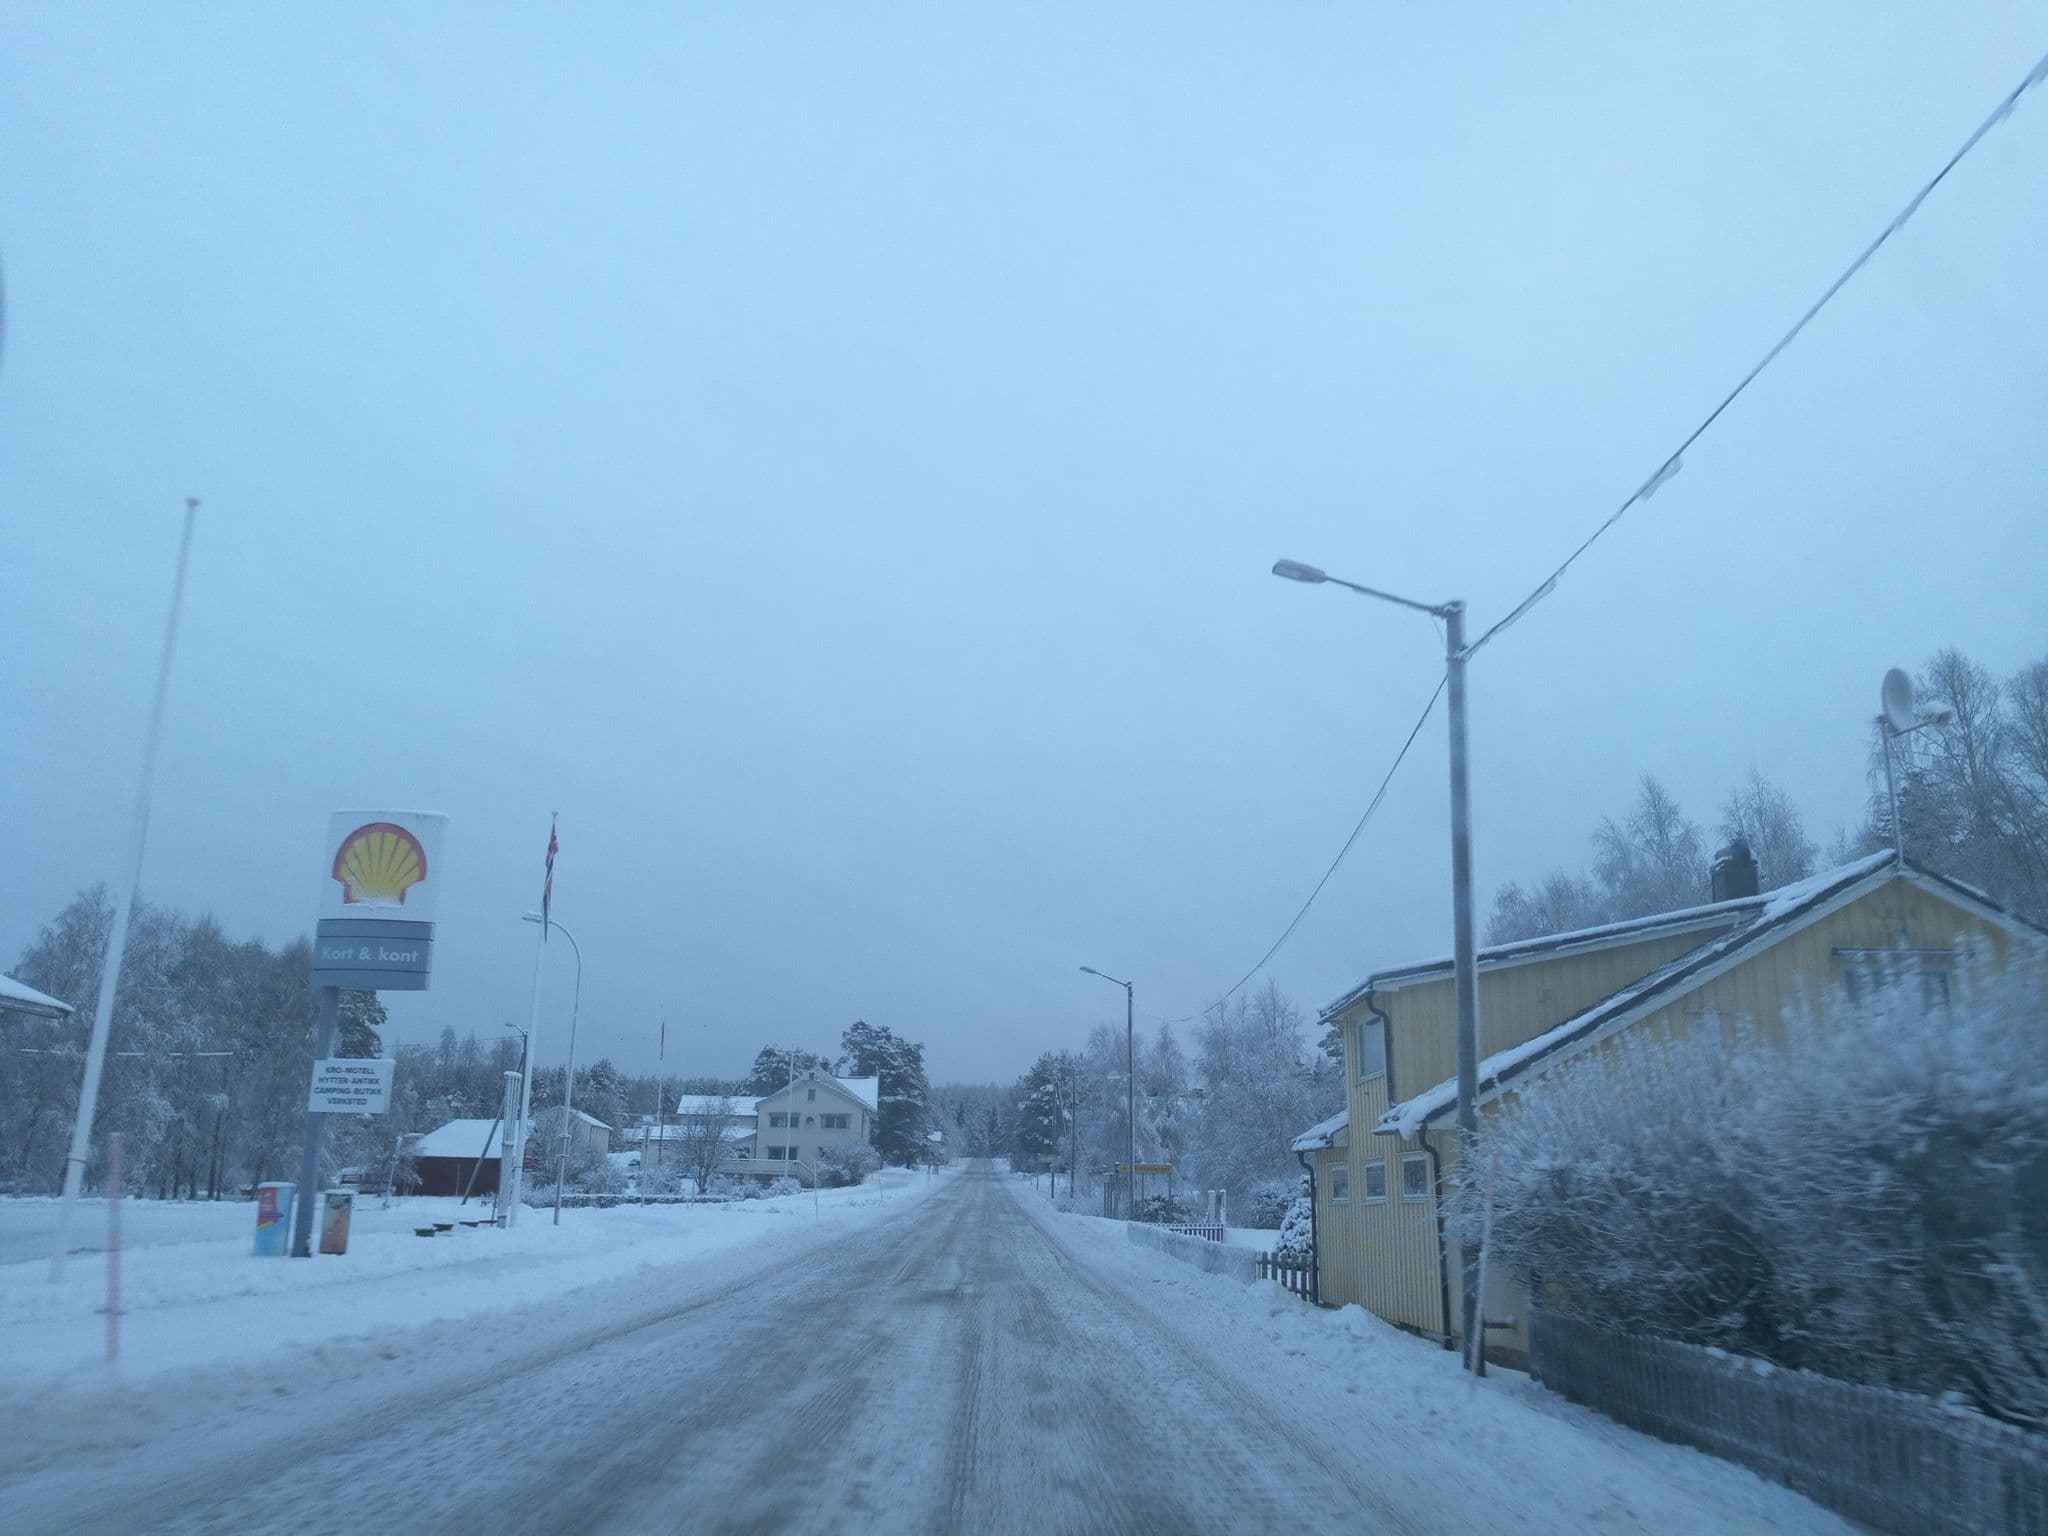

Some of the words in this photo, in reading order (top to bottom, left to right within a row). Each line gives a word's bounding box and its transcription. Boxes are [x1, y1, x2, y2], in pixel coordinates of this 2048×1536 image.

[322, 946, 354, 960] Kort
[358, 946, 372, 960] &
[379, 946, 418, 963] kont
[327, 1097, 368, 1106] VERKSTED
